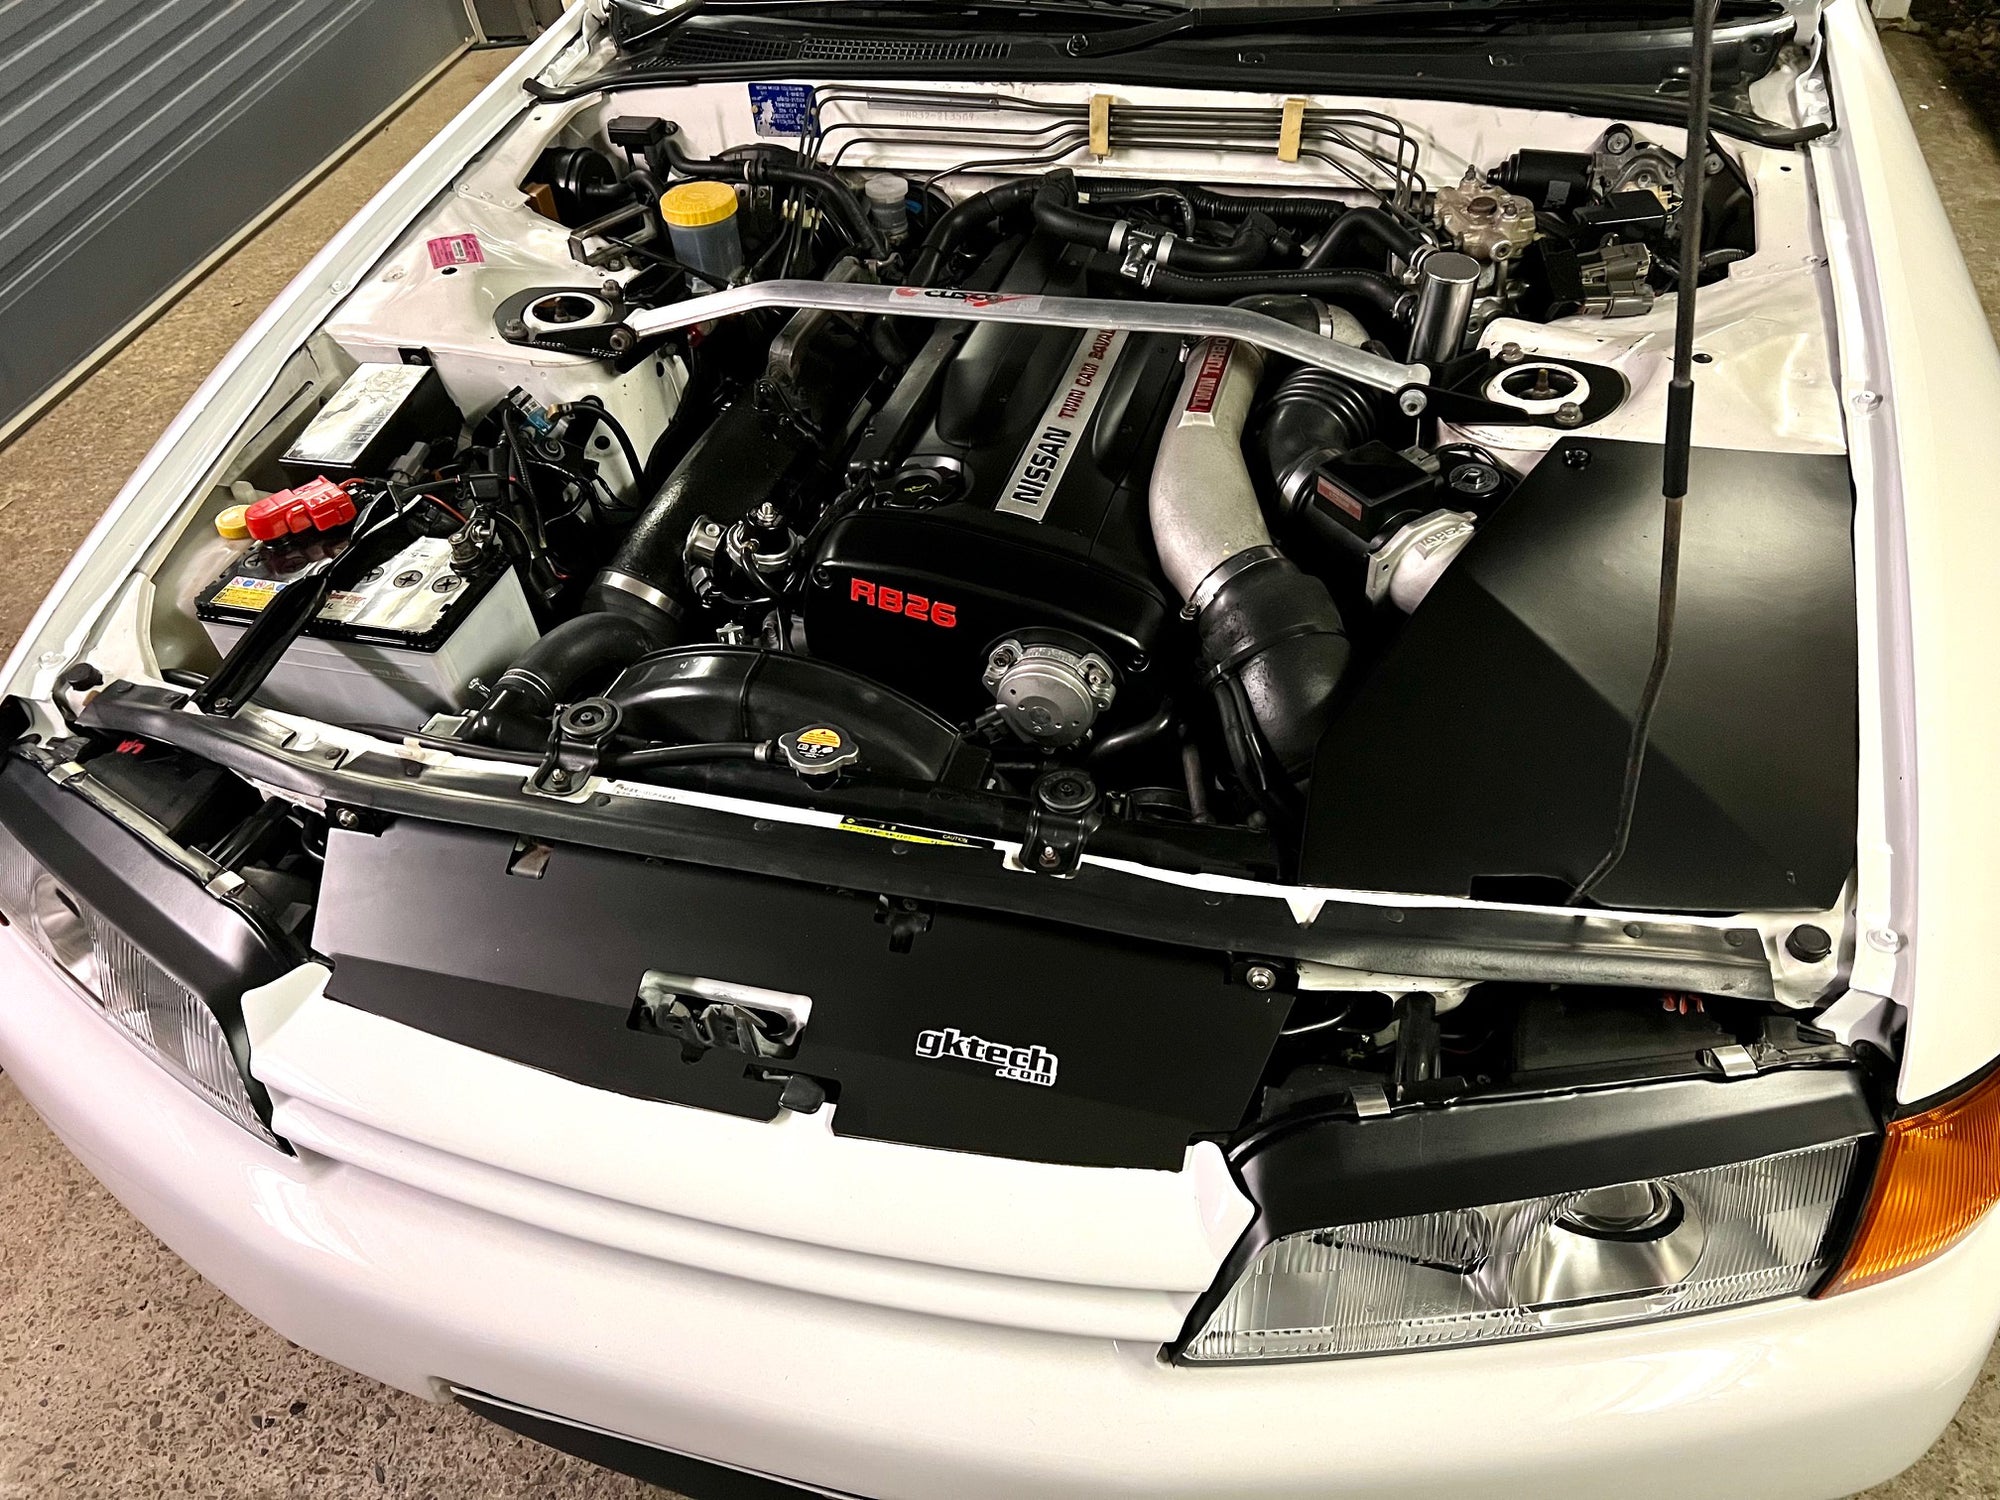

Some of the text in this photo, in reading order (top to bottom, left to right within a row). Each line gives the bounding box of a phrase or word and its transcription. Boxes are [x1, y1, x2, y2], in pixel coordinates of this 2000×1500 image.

[1191, 337, 1230, 408] TWIN TURBO
[1011, 426, 1071, 505] NISSAN
[1058, 389, 1086, 419] TWIN
[1076, 363, 1100, 387] CAM
[851, 577, 957, 628] RB26
[942, 834, 969, 843] CAUTION
[917, 1029, 1056, 1074] gktech
[998, 1066, 1052, 1085] .com
